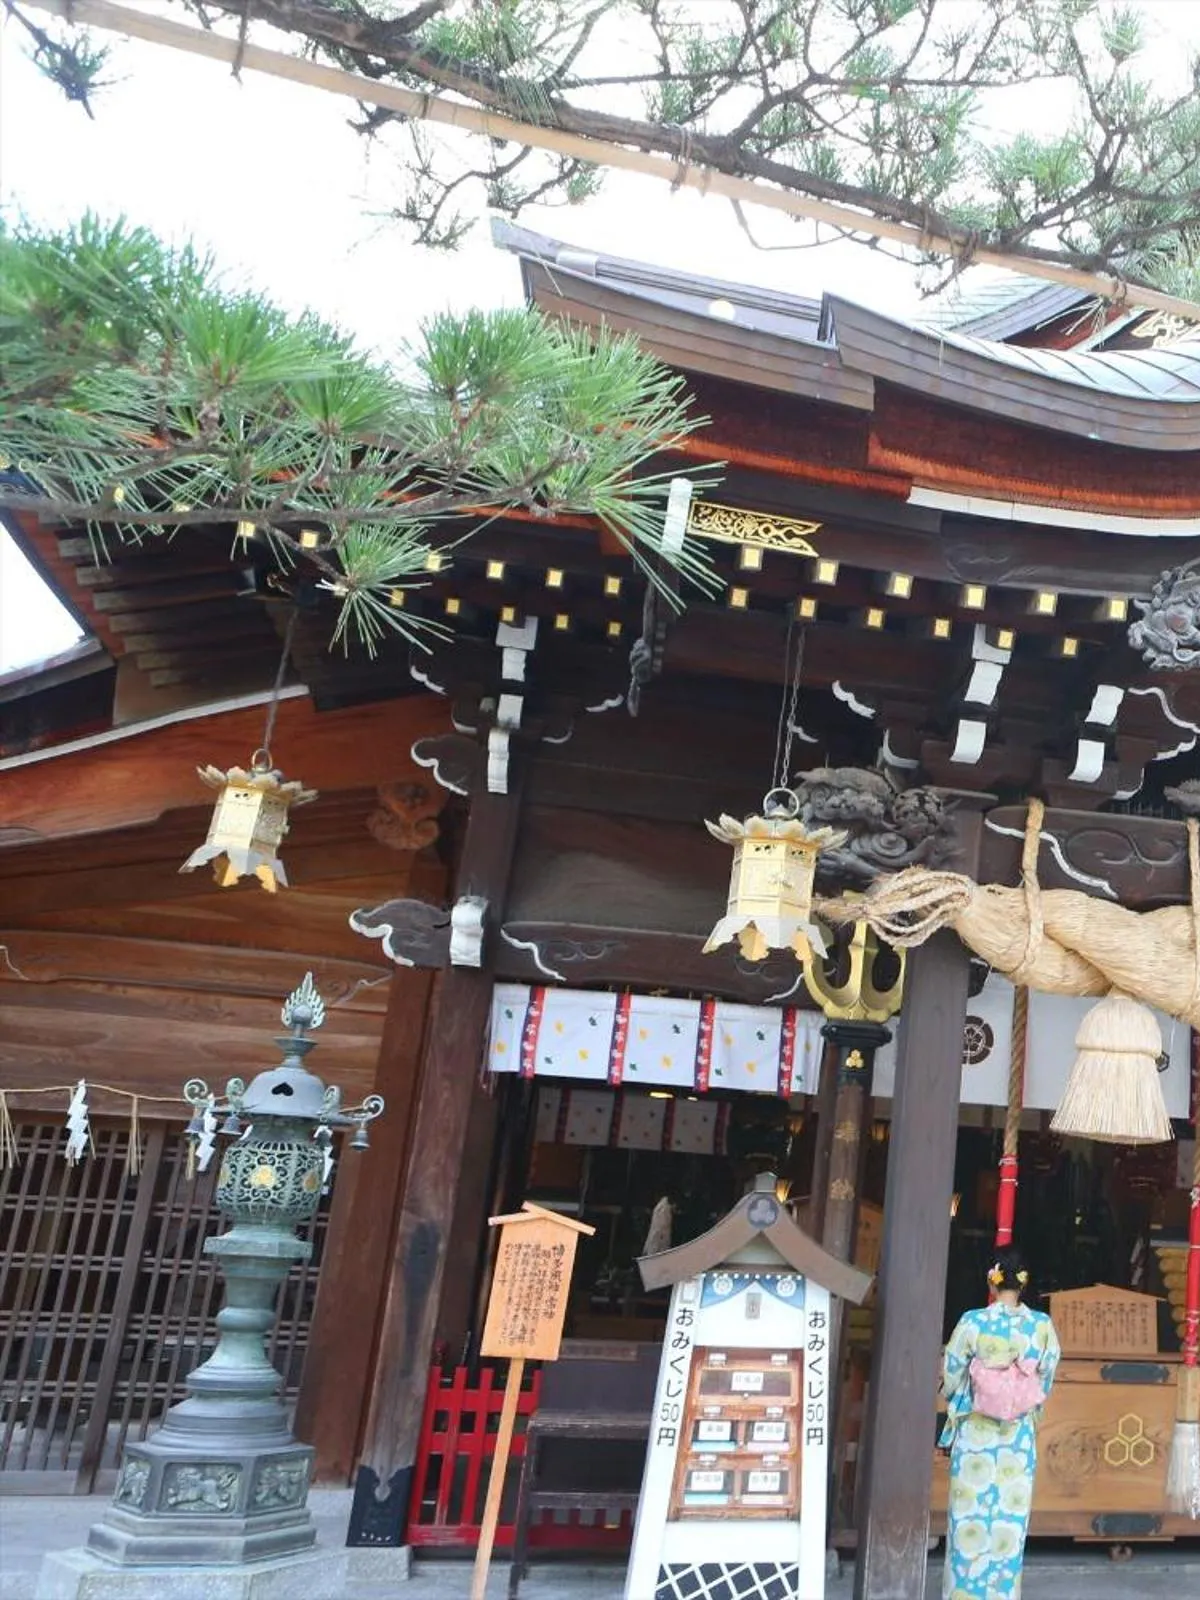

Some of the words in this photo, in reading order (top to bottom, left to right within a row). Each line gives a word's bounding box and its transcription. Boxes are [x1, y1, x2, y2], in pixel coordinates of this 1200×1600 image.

[656, 1307, 694, 1447] おみくじ50円
[807, 1310, 827, 1447] おみくじ50円
